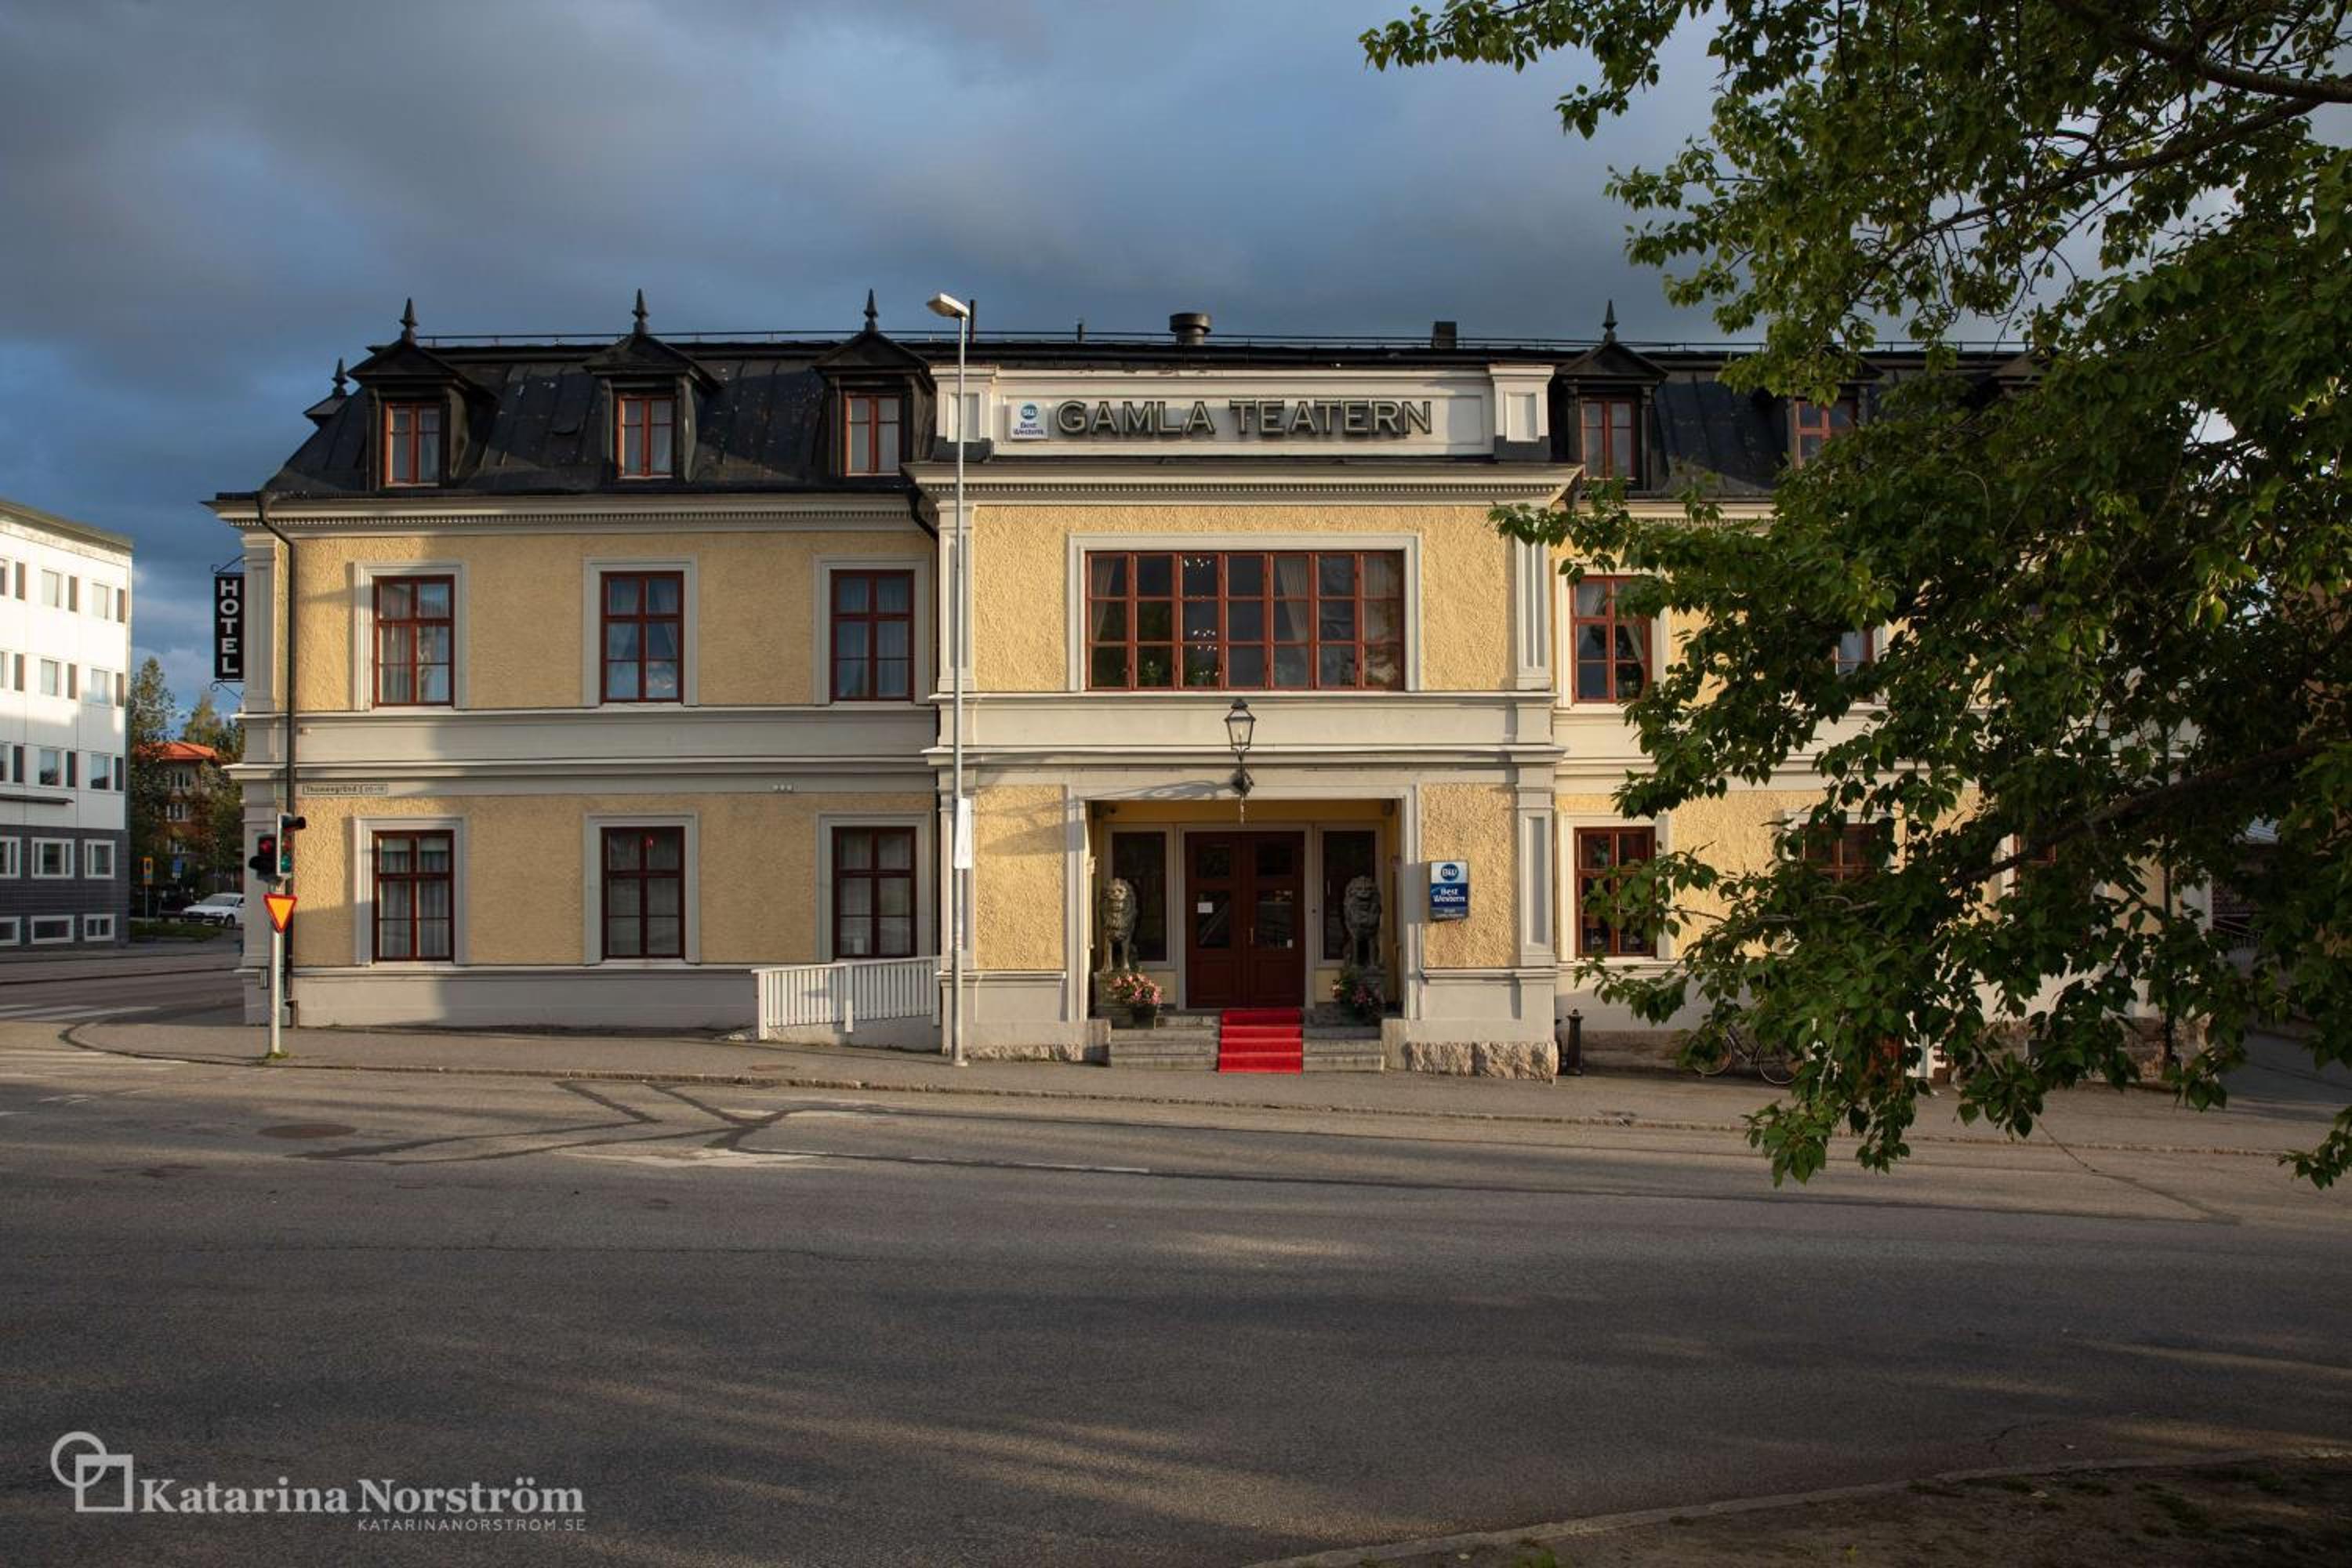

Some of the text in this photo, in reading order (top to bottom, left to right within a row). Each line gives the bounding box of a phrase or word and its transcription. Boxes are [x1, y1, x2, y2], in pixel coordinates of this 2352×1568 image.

[1056, 399, 1432, 436] GAMLA TEATERN
[220, 580, 239, 674] HOTEL
